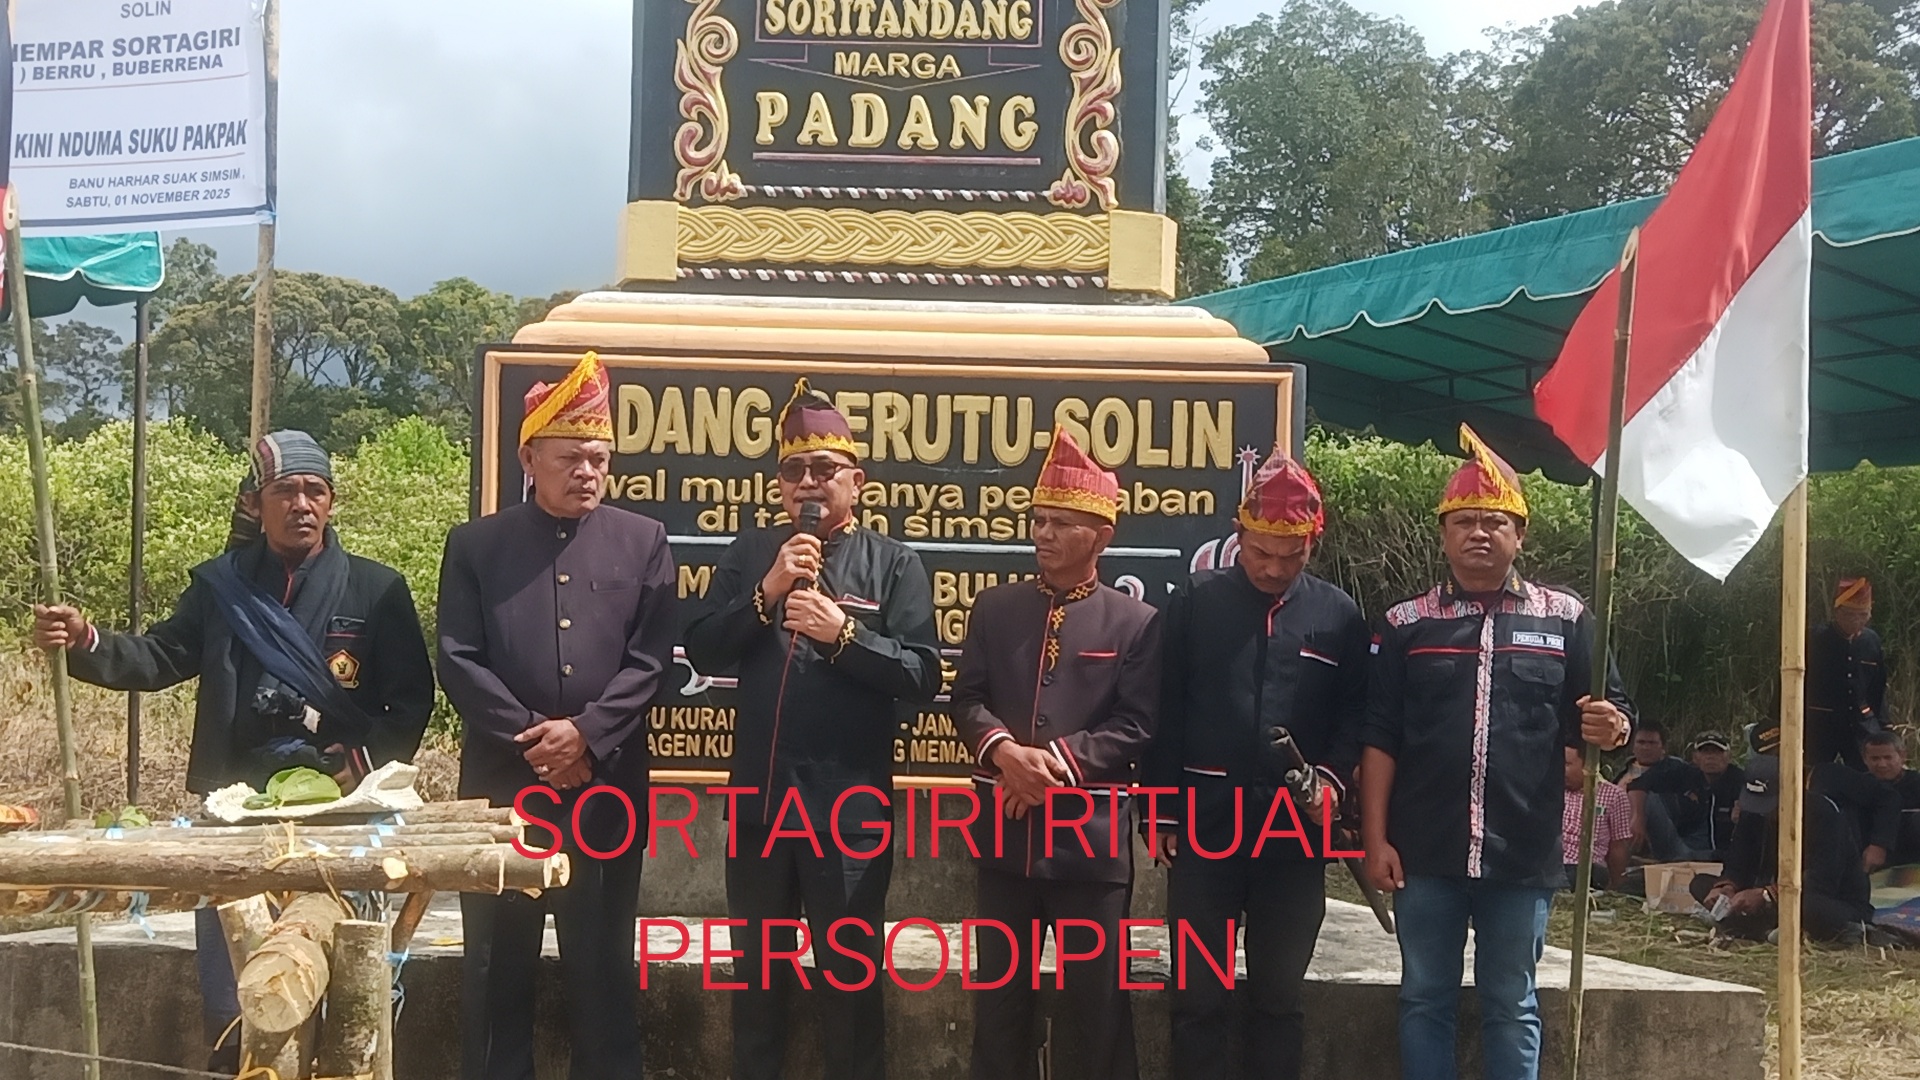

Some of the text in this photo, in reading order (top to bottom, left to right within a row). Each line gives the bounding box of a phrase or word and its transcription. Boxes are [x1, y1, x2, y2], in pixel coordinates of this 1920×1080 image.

[120, 0, 172, 19] SOLIN
[764, 0, 1033, 40] SORITANDANG
[112, 26, 241, 58] SORTAGIRI
[32, 64, 96, 81] BERRU
[112, 54, 223, 76] BUBERRENA
[834, 52, 961, 79] MARGA
[755, 91, 1039, 151] PADANG
[14, 119, 248, 158] KINI NDUMA SUKU PAKPAK
[69, 178, 104, 189] BANU
[107, 174, 159, 188] HARHAR
[162, 172, 197, 184] SUAK
[66, 188, 231, 208] SABTU, 01 NOVEMBER 2025
[601, 469, 666, 502] wal
[697, 505, 739, 532] di
[904, 512, 1036, 541] simsi
